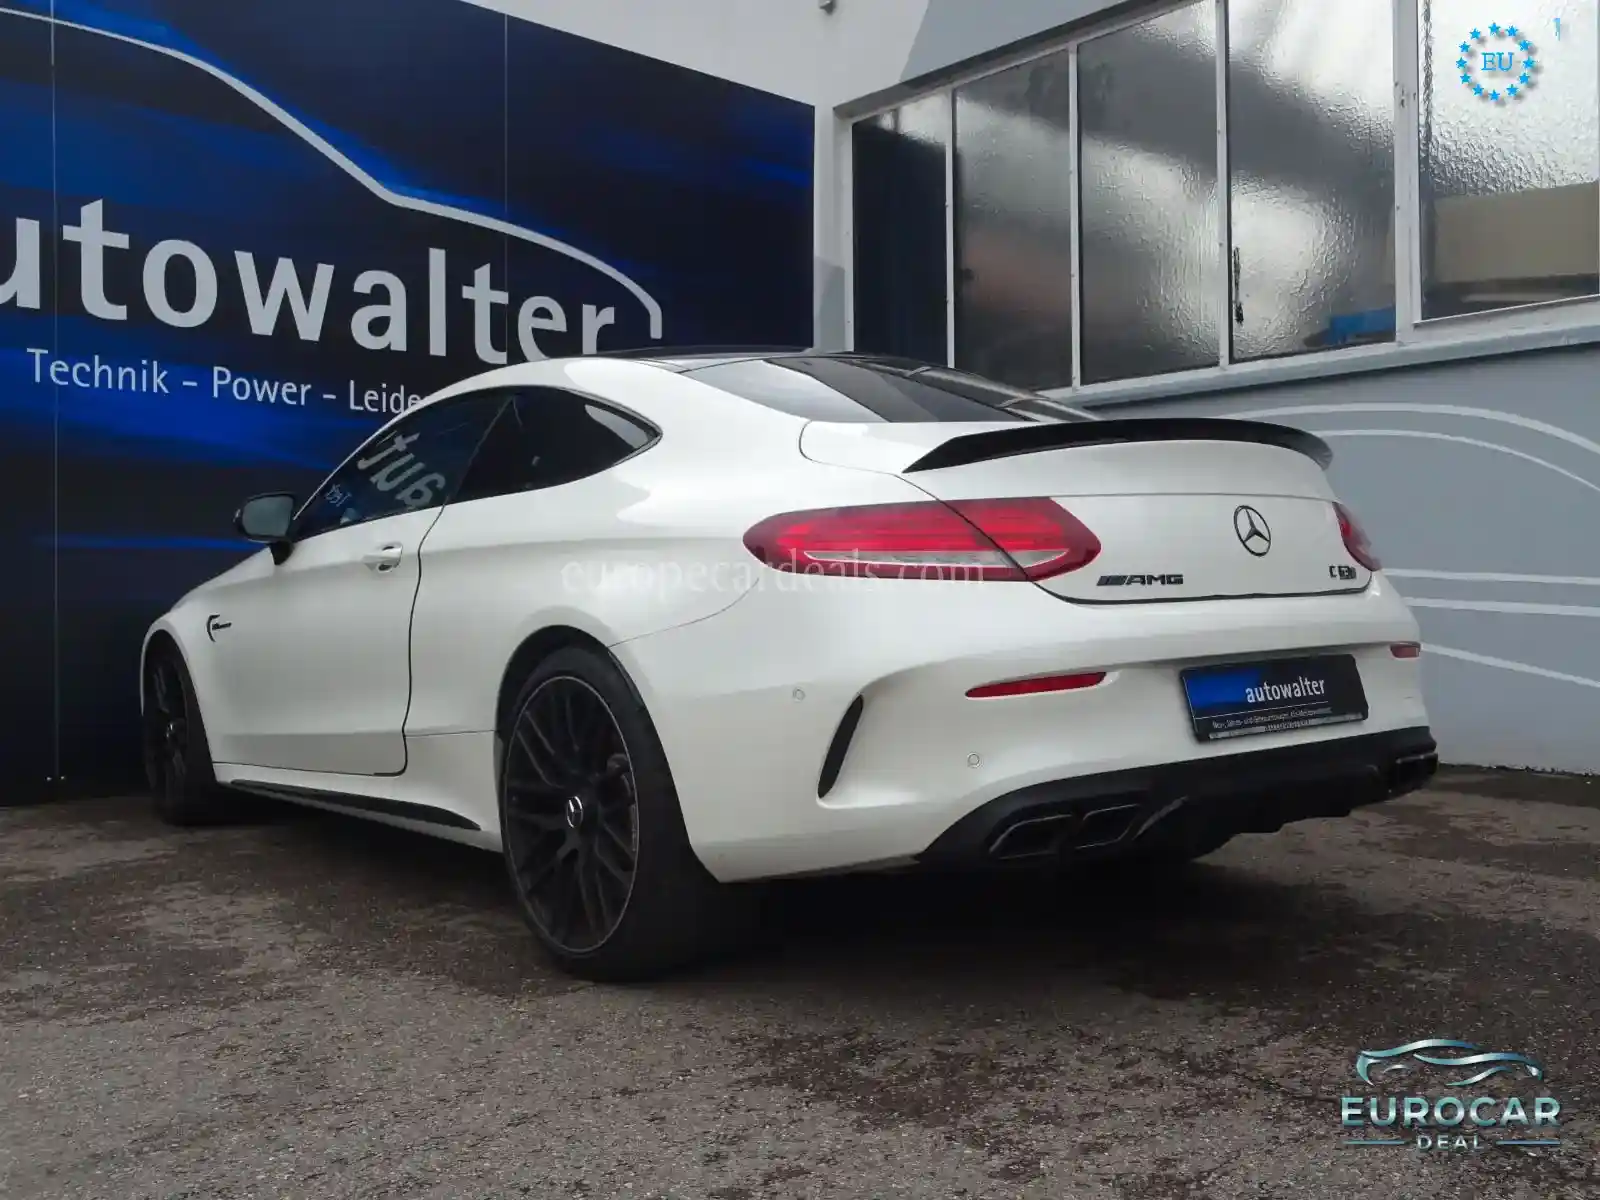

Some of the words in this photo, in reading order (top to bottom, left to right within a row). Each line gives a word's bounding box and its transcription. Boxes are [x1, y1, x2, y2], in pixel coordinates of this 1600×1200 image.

[27, 347, 169, 394] Technik
[212, 366, 312, 405] Power
[1123, 573, 1184, 586] AMG
[1245, 676, 1325, 703] autowalter
